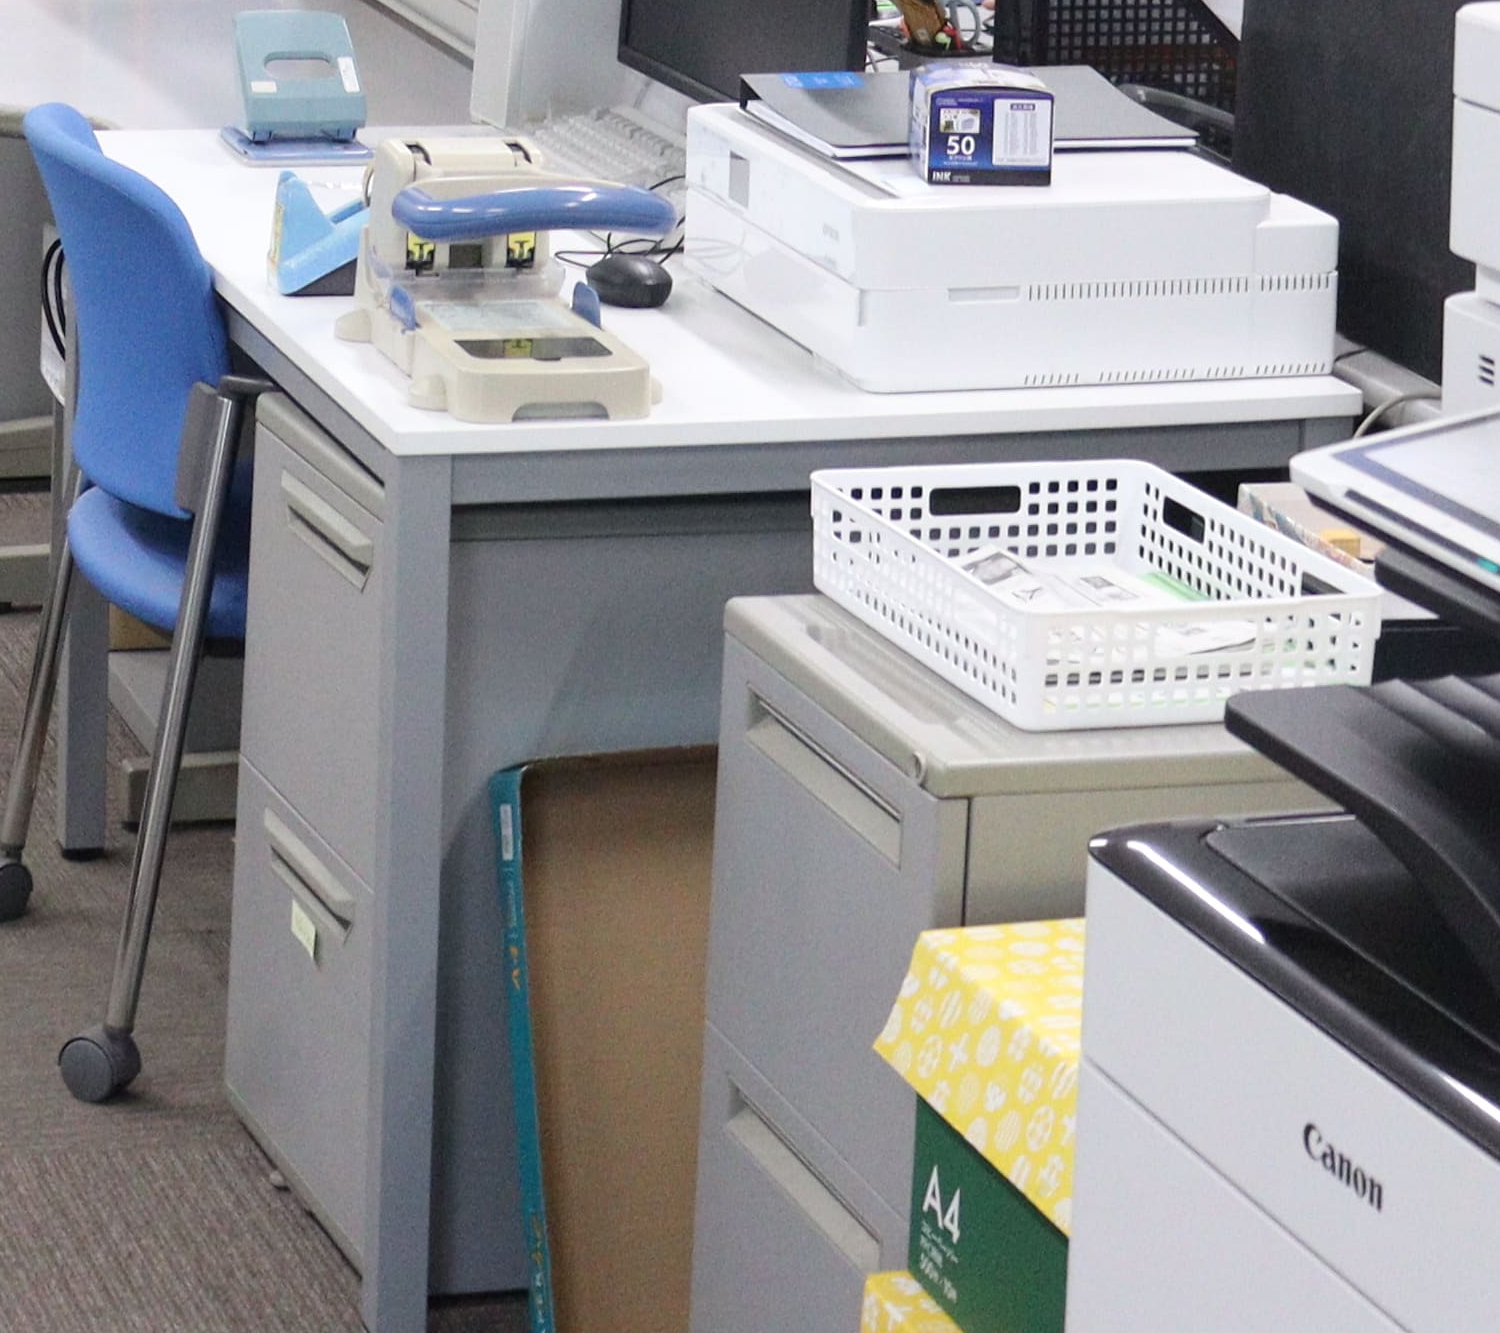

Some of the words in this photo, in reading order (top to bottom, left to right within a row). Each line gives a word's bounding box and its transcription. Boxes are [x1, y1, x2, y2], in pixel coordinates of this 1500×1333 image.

[946, 136, 975, 156] 50
[932, 171, 952, 181] INK
[1301, 1122, 1385, 1212] Canon
[922, 1164, 961, 1245] A4
